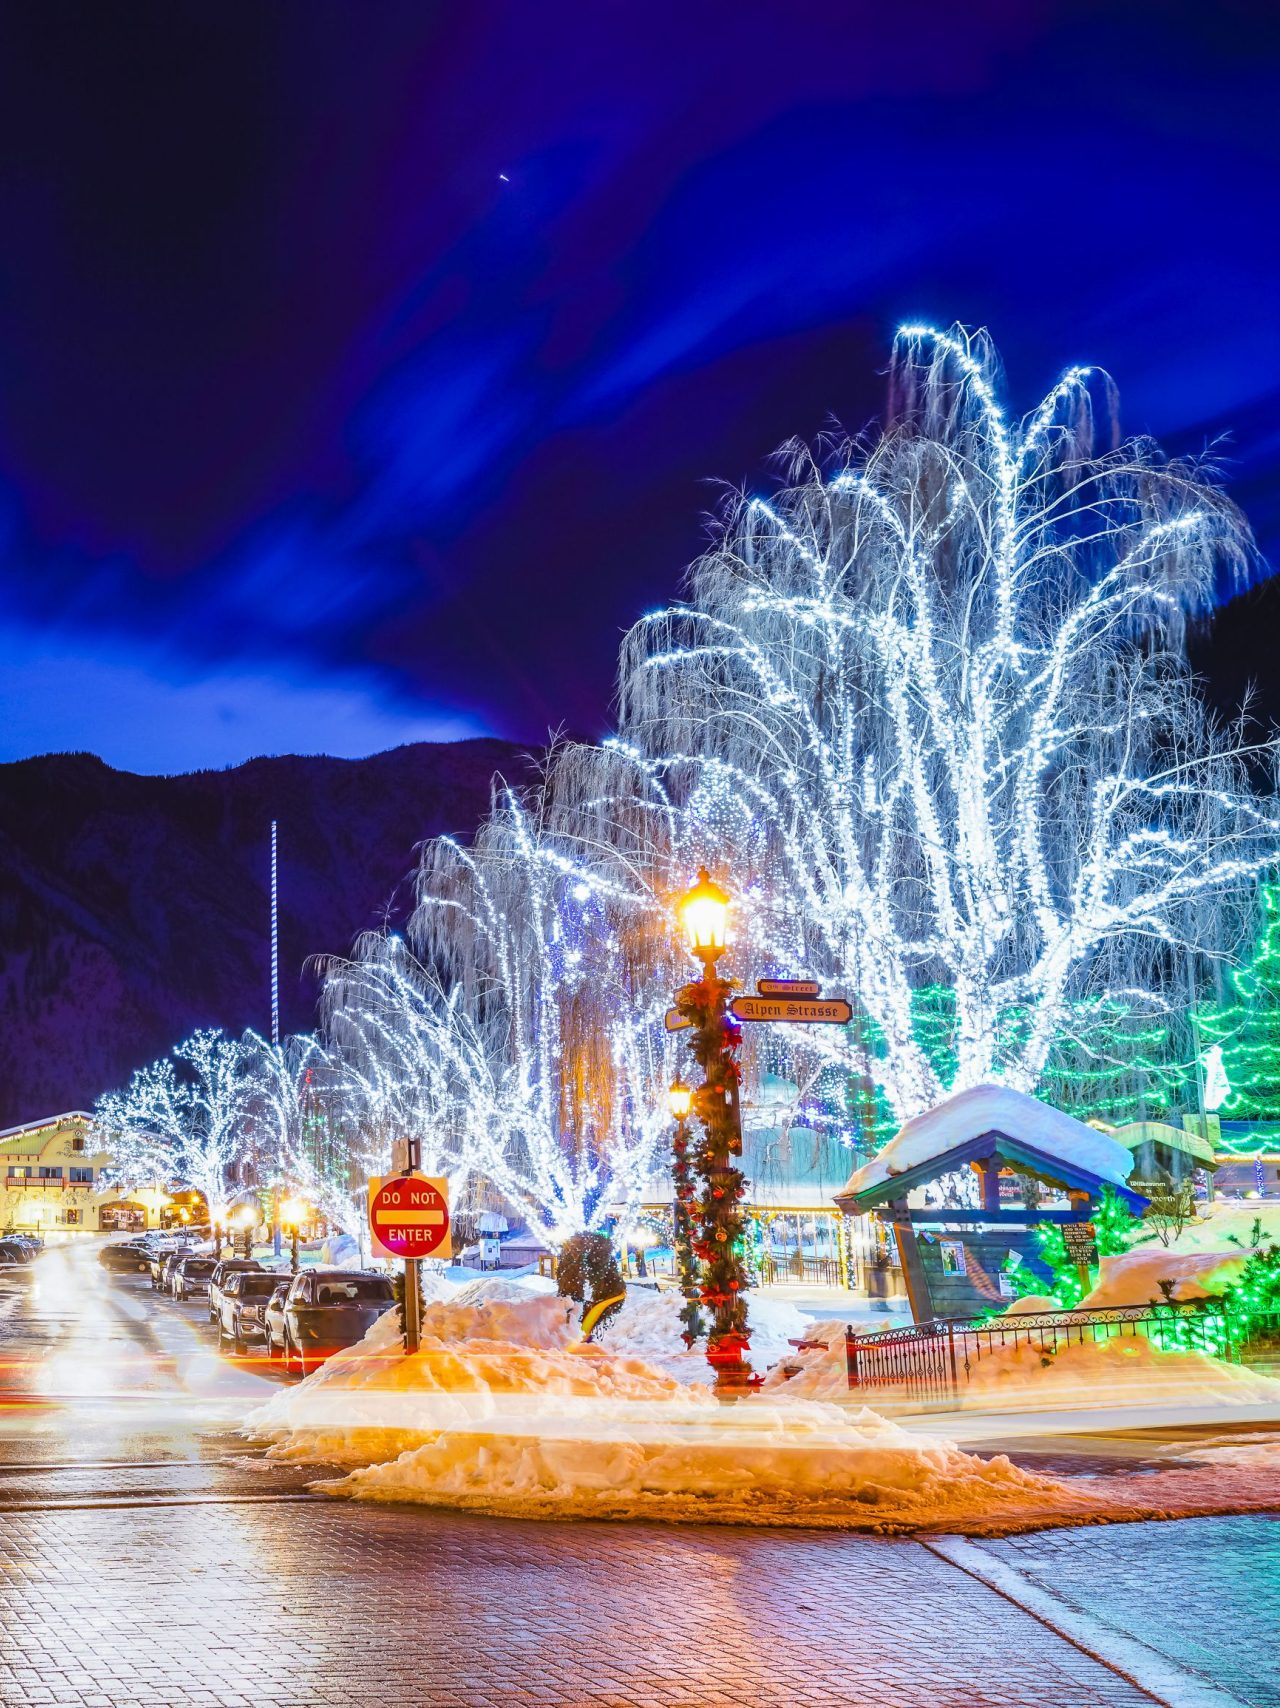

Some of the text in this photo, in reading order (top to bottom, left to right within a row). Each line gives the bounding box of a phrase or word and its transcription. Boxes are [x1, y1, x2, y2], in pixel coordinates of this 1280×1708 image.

[782, 984, 813, 992] Street
[744, 1002, 839, 1018] Alpen Strasse
[382, 1191, 437, 1205] DO NOT
[388, 1228, 433, 1242] ENTER
